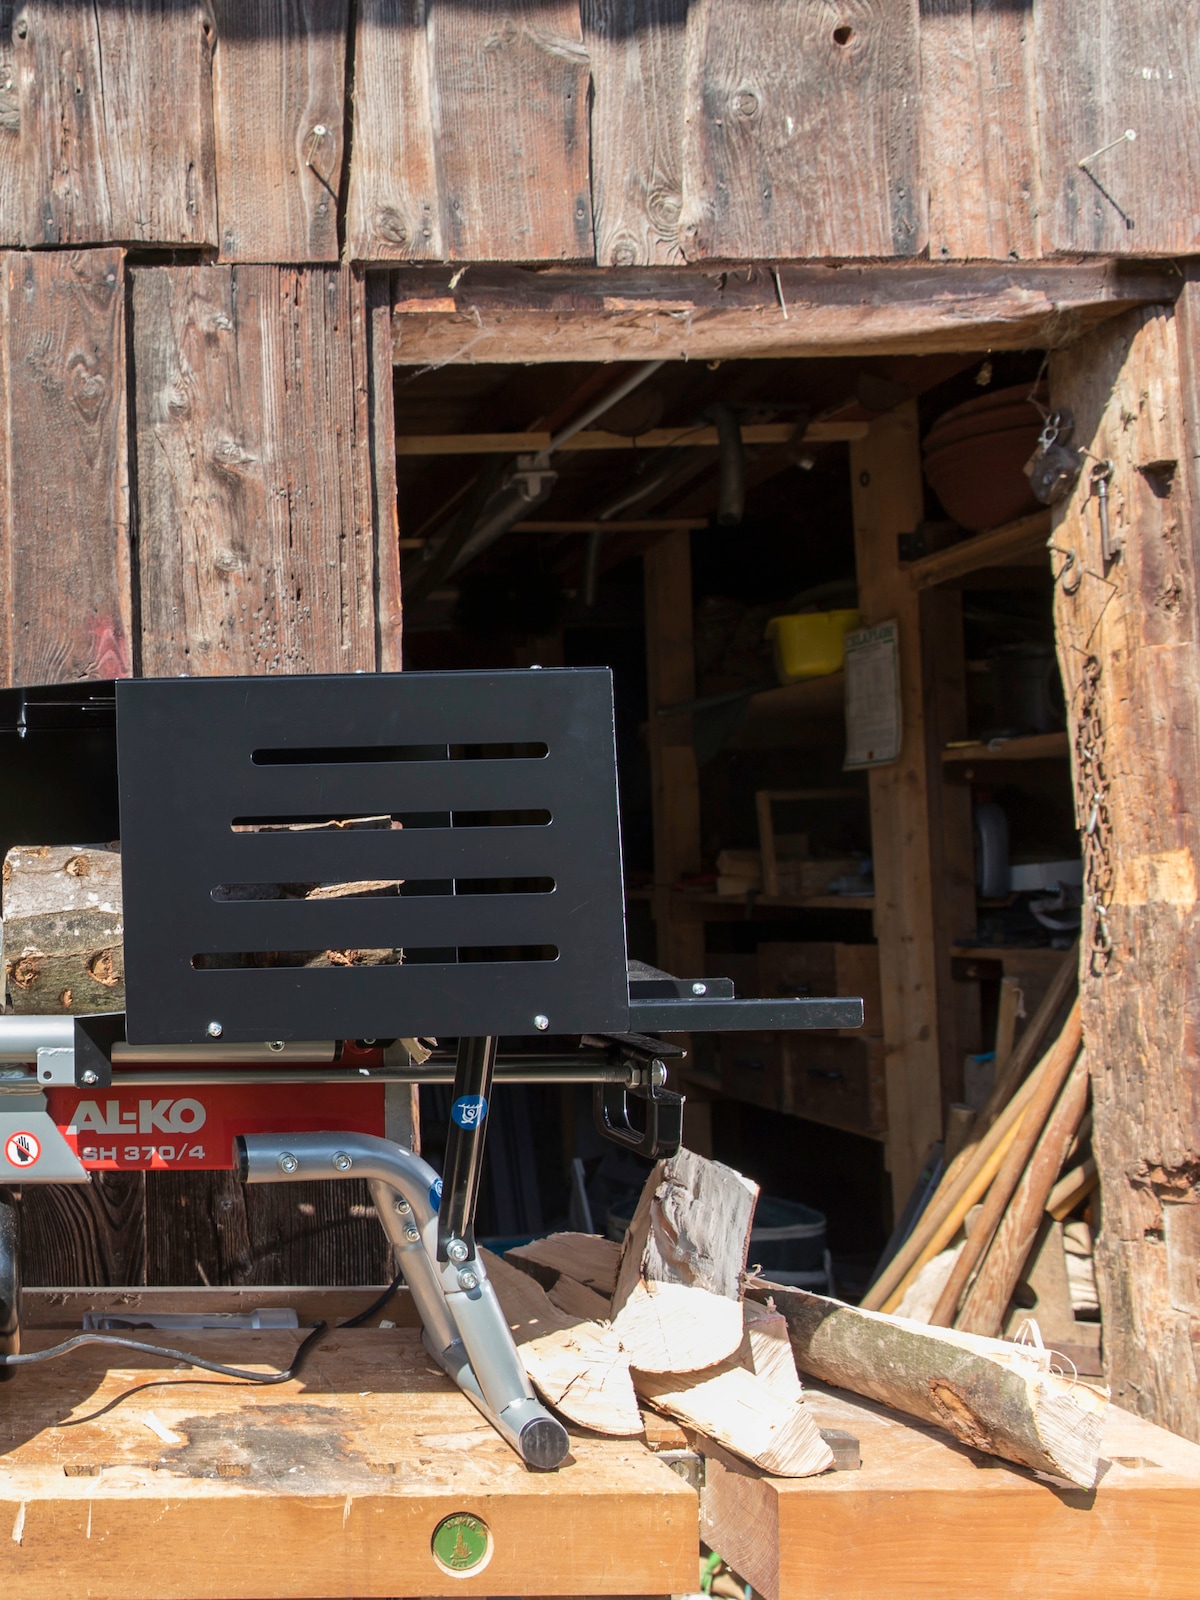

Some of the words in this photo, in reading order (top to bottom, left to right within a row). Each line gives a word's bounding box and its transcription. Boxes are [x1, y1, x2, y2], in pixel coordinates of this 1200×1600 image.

[65, 1097, 207, 1135] AL-KO
[78, 1146, 117, 1161] SH
[124, 1143, 206, 1161] 370/4
